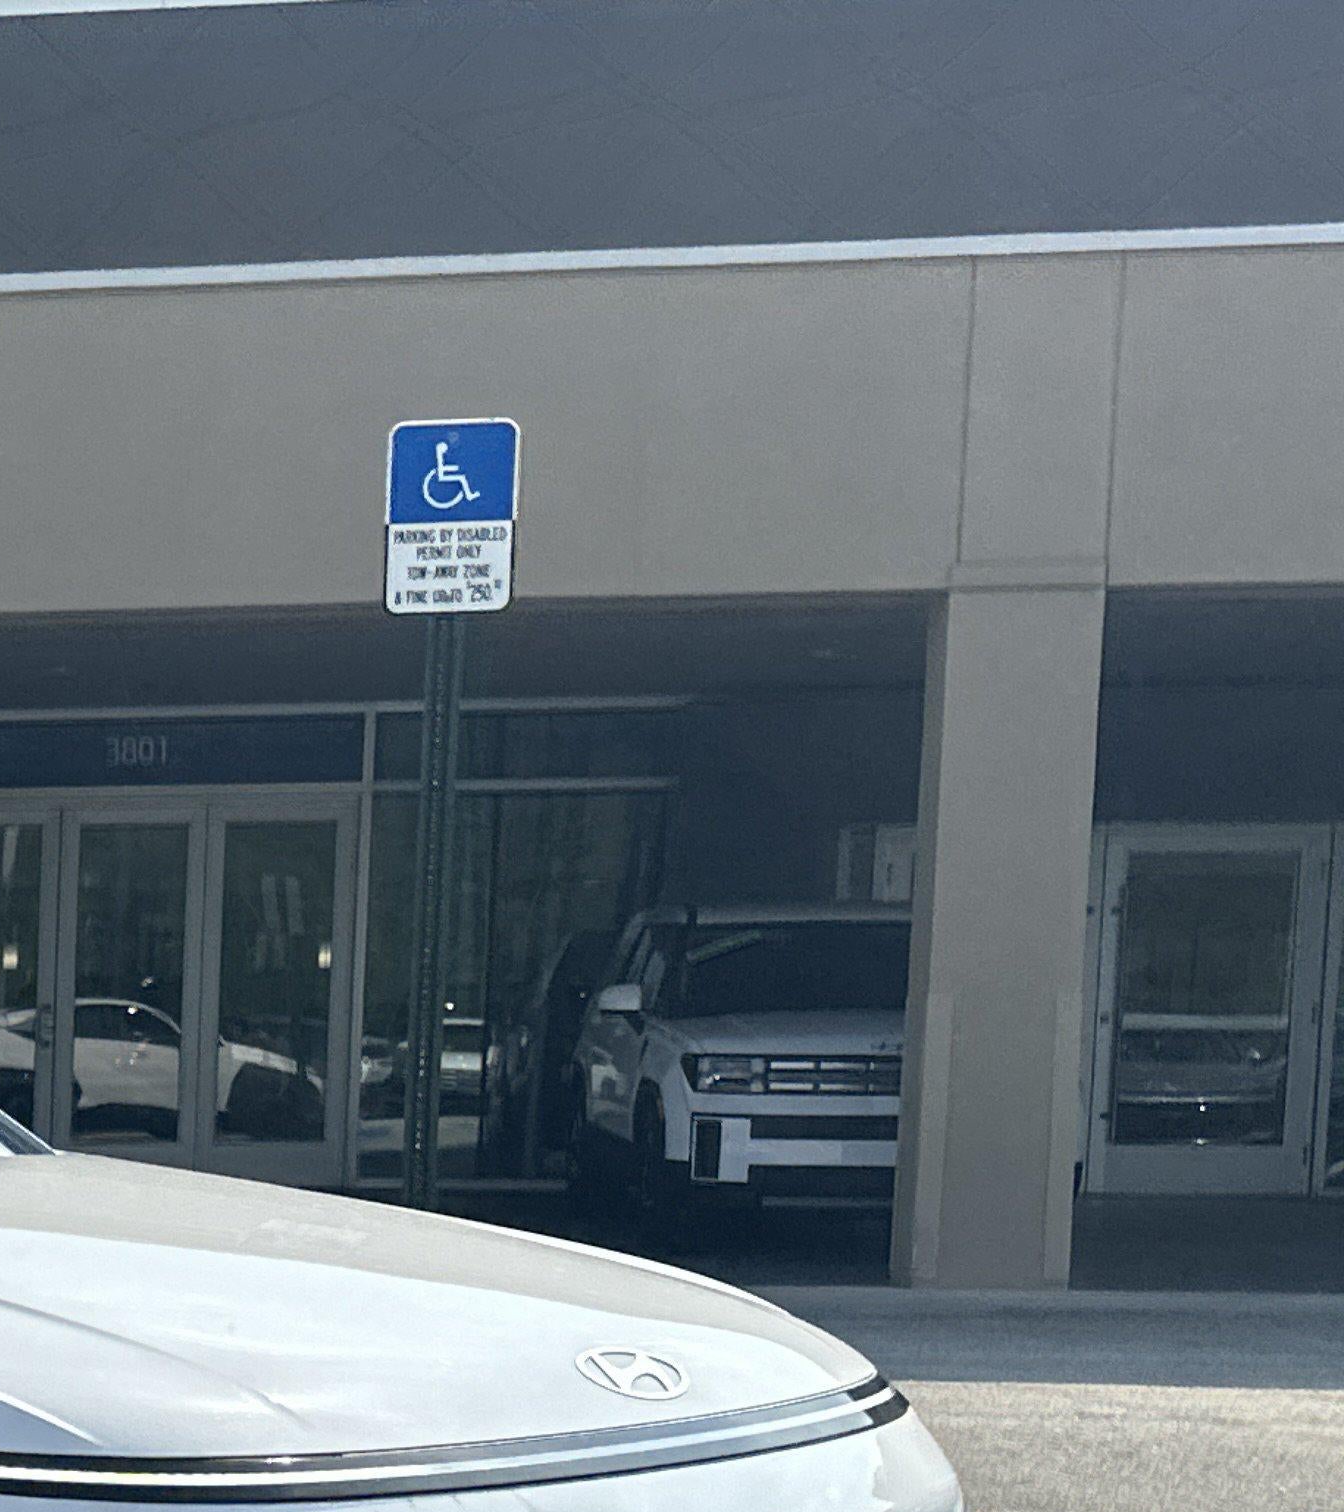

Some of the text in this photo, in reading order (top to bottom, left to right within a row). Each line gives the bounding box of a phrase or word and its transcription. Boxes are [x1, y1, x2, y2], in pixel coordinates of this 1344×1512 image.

[394, 526, 508, 545] PARKING BY DISABLED
[456, 544, 482, 559] ONLY
[463, 563, 491, 579] ZONE
[104, 735, 169, 768] 3801
